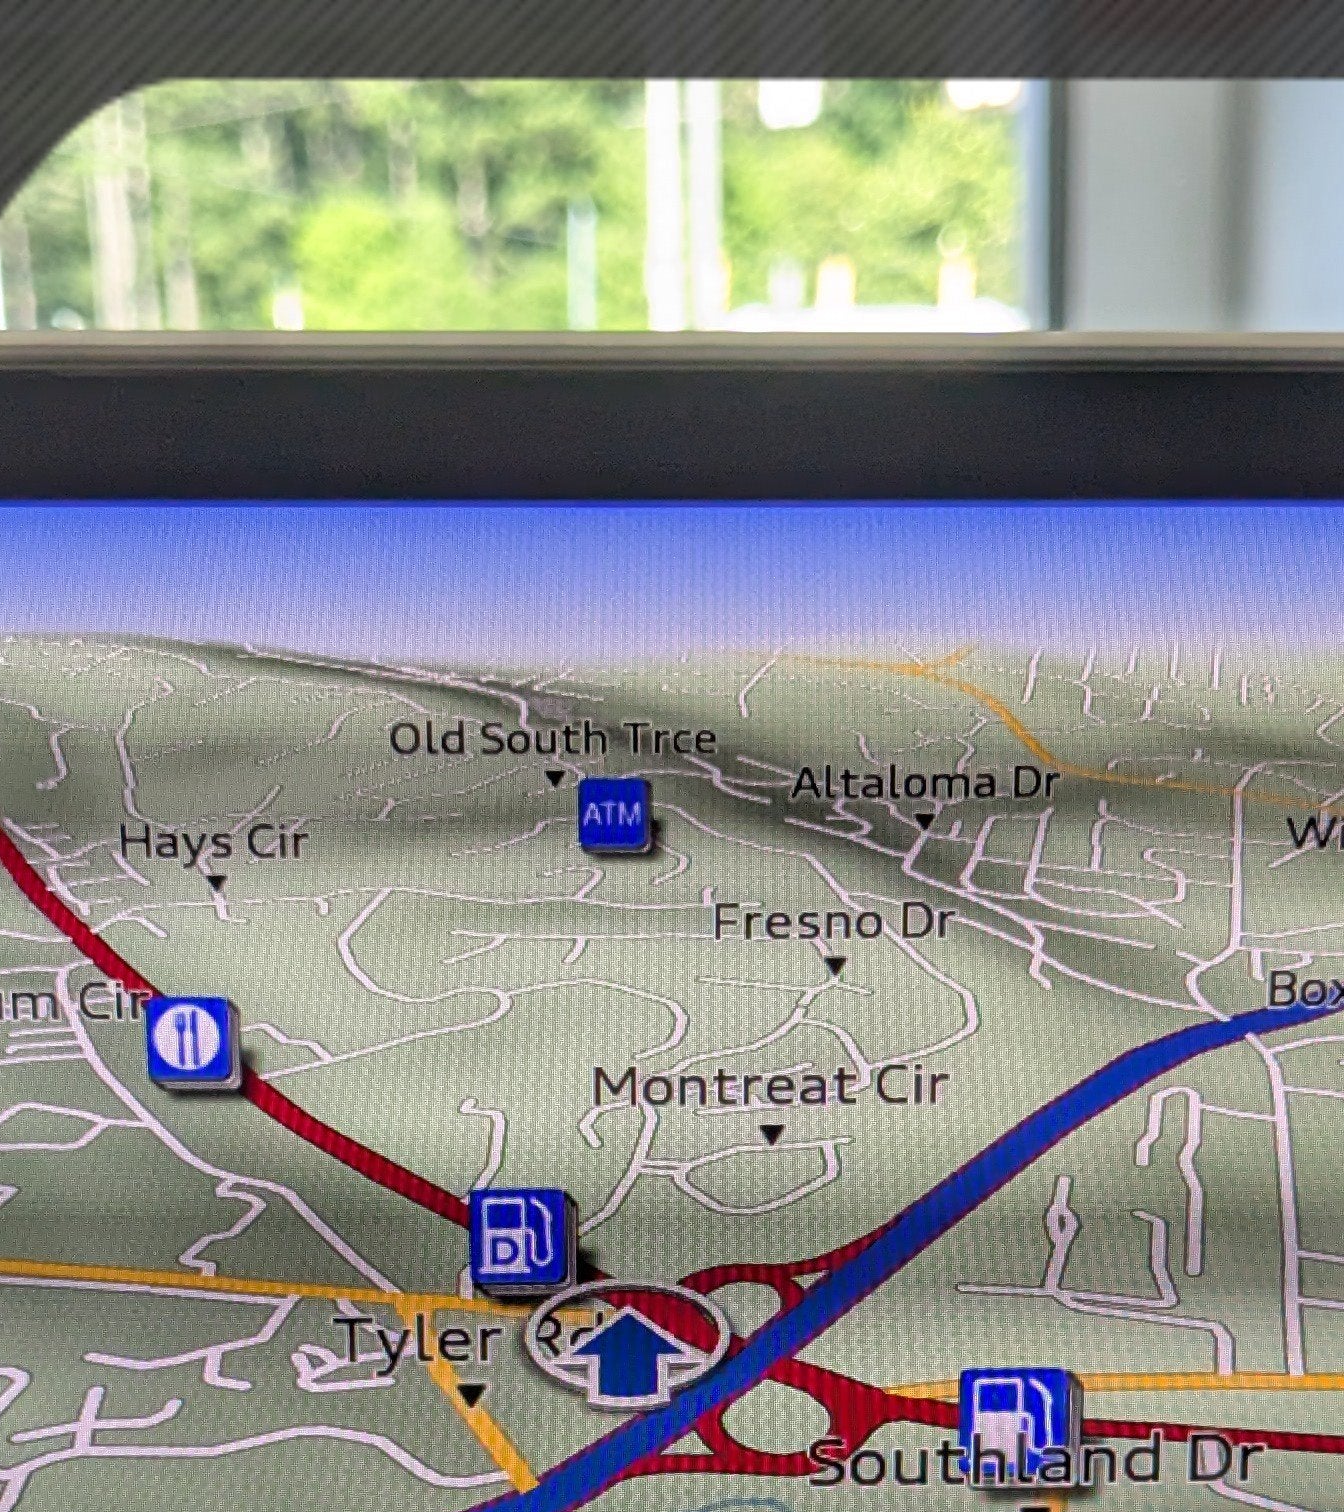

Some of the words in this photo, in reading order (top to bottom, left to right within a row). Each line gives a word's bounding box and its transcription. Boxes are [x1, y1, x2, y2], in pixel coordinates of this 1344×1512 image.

[390, 722, 466, 756] Old
[480, 722, 607, 756] South
[623, 723, 717, 755] Trce
[791, 764, 996, 800] Altaloma
[1013, 765, 1061, 798] Dr
[582, 800, 642, 827] ATM
[119, 824, 233, 868] Hays
[247, 824, 310, 859] Cir
[714, 902, 884, 939] Fresno
[901, 901, 956, 938] Dr
[79, 980, 151, 1021] Cir
[593, 1065, 857, 1107] Montreat
[876, 1063, 950, 1105] Cir
[332, 1312, 503, 1377] Tyler
[809, 1432, 1162, 1487] Southland
[1190, 1433, 1266, 1483] Dr
